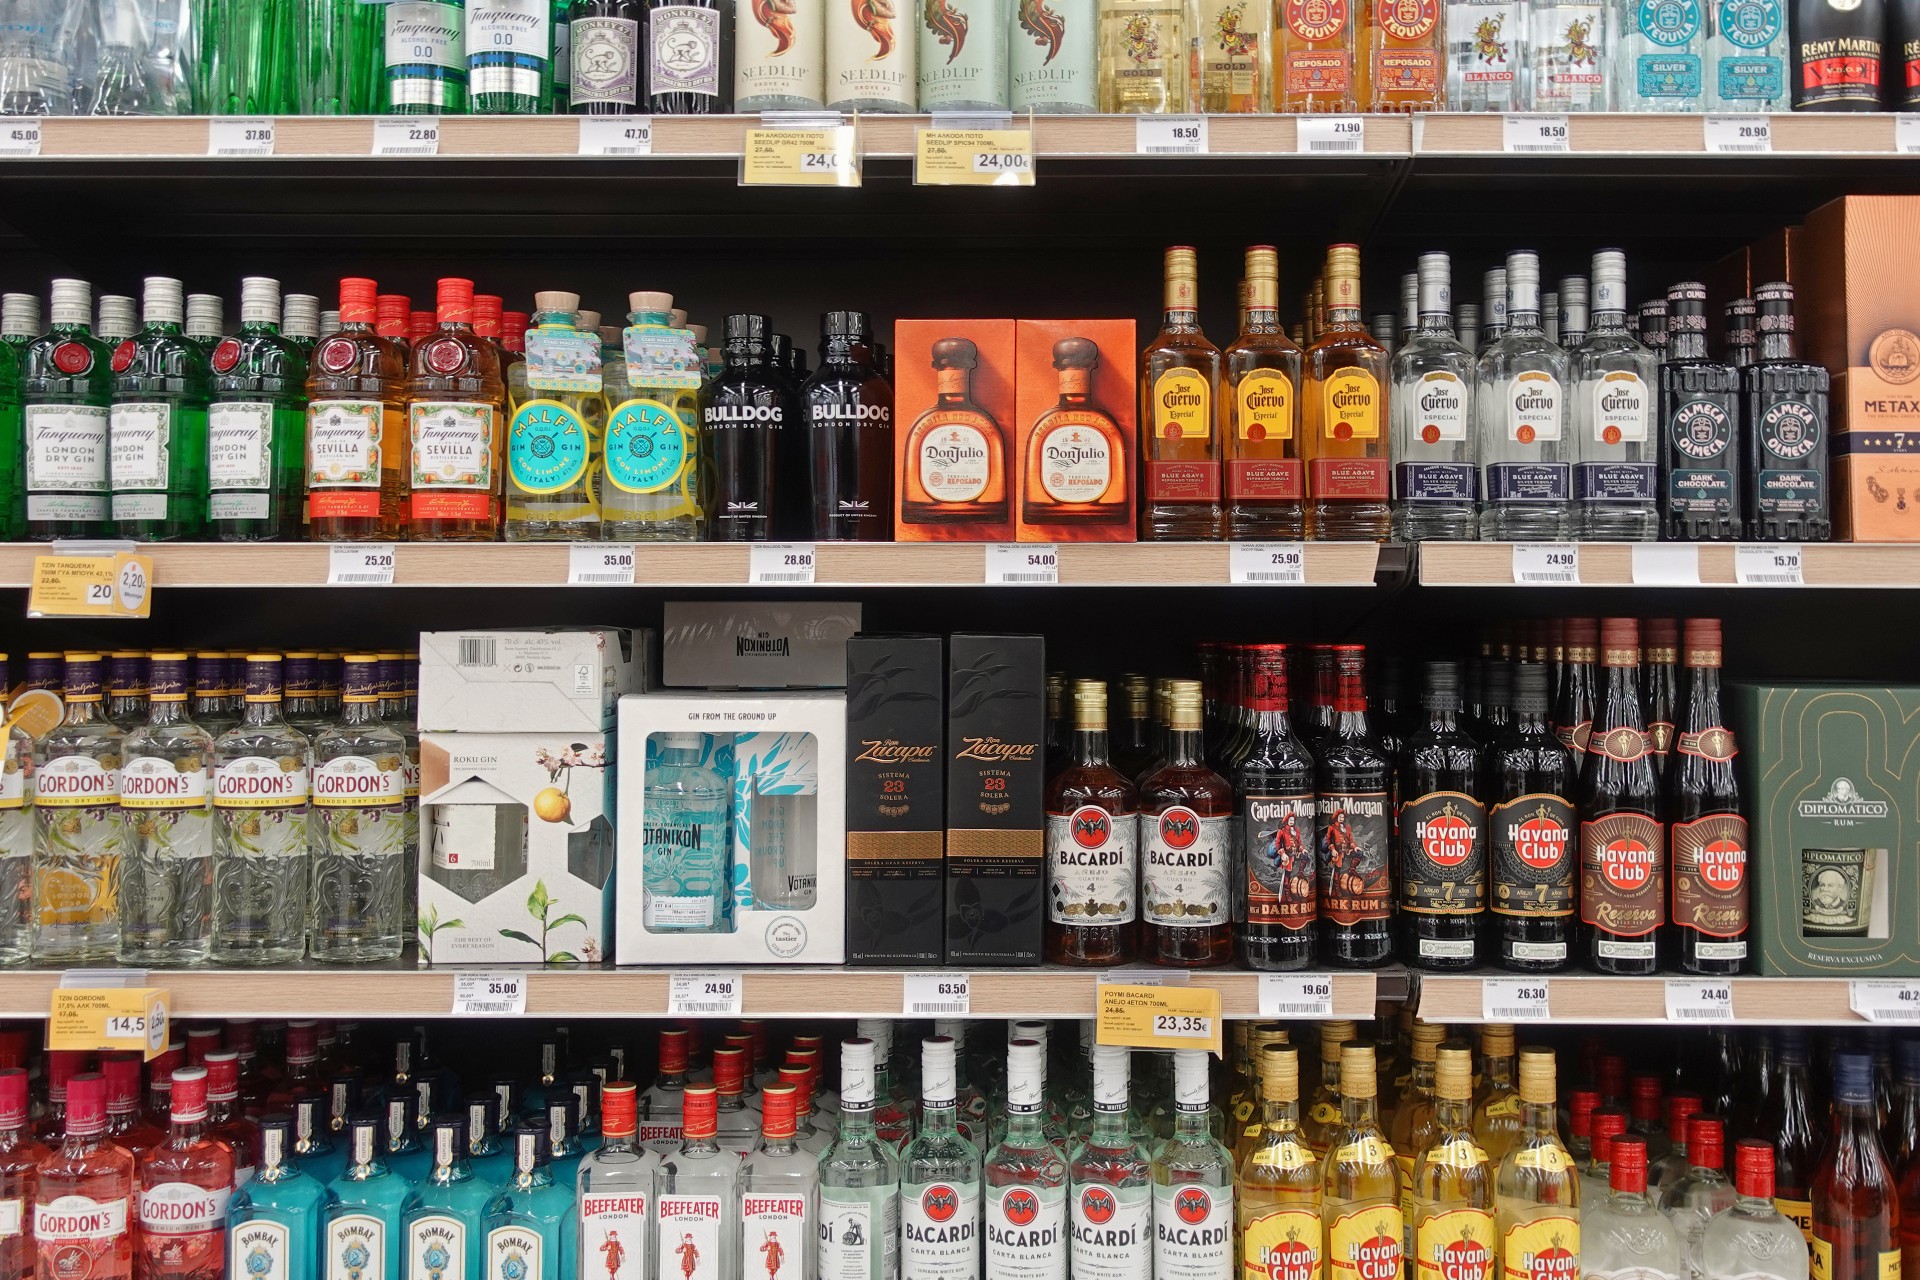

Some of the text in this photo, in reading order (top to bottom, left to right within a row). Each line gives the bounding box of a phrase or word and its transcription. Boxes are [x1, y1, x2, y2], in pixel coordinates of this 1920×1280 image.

[471, 7, 541, 29] Tanqueray
[391, 20, 461, 42] Tanqueray
[1293, 19, 1340, 40] TEQUILA
[1385, 19, 1432, 40] TEQUILA
[1641, 24, 1694, 45] TEQUILA
[1722, 24, 1776, 46] TEQUILA
[493, 33, 513, 46] 0.0
[1801, 37, 1882, 58] RÉMY MARTIN
[414, 45, 433, 58] 0.0
[1215, 63, 1247, 71] GOLD
[1293, 59, 1341, 68] REPOSADO
[1384, 59, 1432, 68] REPOSADO
[1653, 63, 1687, 73] SILVER
[1734, 65, 1768, 75] SILVER
[742, 66, 805, 84] SEEDLIP
[840, 69, 905, 86] SEEDLIP
[921, 67, 980, 86] SEEDLIP
[1014, 69, 1076, 89] SEEDLIP
[1466, 72, 1513, 81] BLANCO
[1555, 74, 1602, 83] BLANCO
[11, 129, 38, 140] 45.00
[245, 129, 271, 140] 37.80
[409, 129, 436, 140] 22.80
[624, 128, 649, 139] 47.70
[1172, 127, 1198, 138] 18.50
[1334, 122, 1360, 133] 21.90
[1540, 126, 1566, 137] 18.50
[1739, 126, 1767, 137] 20.90
[926, 139, 952, 147] SEEDLIP
[976, 139, 996, 147] 700ML
[1175, 383, 1191, 394] Jose
[1259, 384, 1274, 395] Jose
[1345, 383, 1360, 394] Jose
[1432, 387, 1449, 397] Jose
[1527, 387, 1543, 397] Jose
[1613, 387, 1630, 397] Jose
[1163, 391, 1201, 408] Cuervo
[1246, 392, 1285, 410] Cuervo
[1332, 391, 1371, 408] Cuervo
[1421, 395, 1459, 412] Cuervo
[1516, 395, 1553, 412] Cuervo
[1602, 395, 1640, 412] Cuervo
[705, 406, 782, 423] BULLDOG
[812, 403, 890, 422] BULLDOG
[1170, 410, 1195, 420] Especial
[1678, 403, 1725, 424] OLMECA
[1766, 403, 1814, 424] OLMECA
[313, 425, 365, 440] Tanqueray
[513, 410, 579, 438] MALFY
[612, 410, 677, 438] MALFY
[36, 425, 105, 444] Tanqueray
[421, 426, 480, 442] Tanqueray
[45, 446, 95, 455] LONDON
[317, 443, 359, 454] SEVILLA
[427, 444, 473, 456] SEVILLA
[46, 454, 95, 463] DRY GIN
[947, 478, 982, 486] REPOSADO
[1068, 478, 1103, 486] REPOSADO
[1690, 474, 1714, 482] DARK
[1779, 474, 1802, 482] DARK
[365, 555, 392, 566] 25.20
[604, 555, 632, 566] 35.00
[784, 555, 812, 566] 28.80
[1028, 554, 1055, 566] 54.00
[1271, 553, 1299, 565] 25.90
[1546, 554, 1574, 565] 24.90
[1774, 556, 1798, 567] 15.70
[688, 712, 777, 721] GIN FROM THE GROUND UP
[855, 739, 934, 764] Zacapa
[956, 737, 1035, 762] Zacapa
[39, 773, 114, 794] GORDON'S
[122, 774, 189, 794] GORDON'S
[219, 773, 293, 794] GORDON'S
[317, 773, 389, 794] GORDON'S
[878, 771, 911, 780] SISTEMA
[883, 780, 905, 793] 23
[984, 778, 1006, 791] 23
[1250, 801, 1291, 822] Captain
[1342, 797, 1384, 818] Morgan
[1415, 822, 1477, 841] Havana
[1833, 819, 1854, 827] RUM
[1508, 823, 1569, 843] Havana
[1060, 846, 1124, 867] BACARDÍ
[1150, 847, 1213, 867] BACARDÍ
[1428, 841, 1466, 858] Club
[1522, 842, 1559, 860] Club
[1596, 844, 1655, 864] Havana
[1692, 846, 1747, 865] Havana
[470, 859, 492, 867] 700ml
[1608, 863, 1645, 881] Club
[1706, 865, 1739, 882] Club
[1441, 882, 1455, 902] 7
[1534, 884, 1550, 903] 7
[1261, 904, 1299, 915] DARK
[1596, 901, 1657, 927] Reserva
[1807, 952, 1883, 963] RESERVA EXCLUSIVA
[488, 983, 516, 994] 35.00
[704, 983, 732, 994] 24.90
[938, 983, 966, 994] 63.50
[1302, 984, 1329, 995] 19.60
[1517, 988, 1545, 999] 26.30
[1701, 989, 1728, 1000] 24.40
[143, 1197, 216, 1220] GORDON'S
[584, 1197, 645, 1218] BEEFEATER
[660, 1200, 720, 1219] BEEFEATER
[744, 1198, 804, 1217] BEEFEATER
[40, 1211, 110, 1234] GORDON'S
[906, 1216, 975, 1244] BACARDÍ
[240, 1231, 280, 1248] BOMBAY
[337, 1226, 376, 1244] BOMBAY
[418, 1227, 456, 1244] BOMBAY
[989, 1222, 1057, 1248] BACARDÍ
[1071, 1222, 1136, 1248] BACARDÍ
[1159, 1221, 1228, 1247] BACARDÍ
[496, 1237, 534, 1255] BOMBAY
[910, 1246, 971, 1256] CARTA BLANCA
[1348, 1239, 1403, 1261] Havana
[1433, 1243, 1491, 1262] Havana
[1260, 1245, 1317, 1265] Havana
[1522, 1252, 1579, 1272] Havana
[1362, 1262, 1396, 1280] Club
